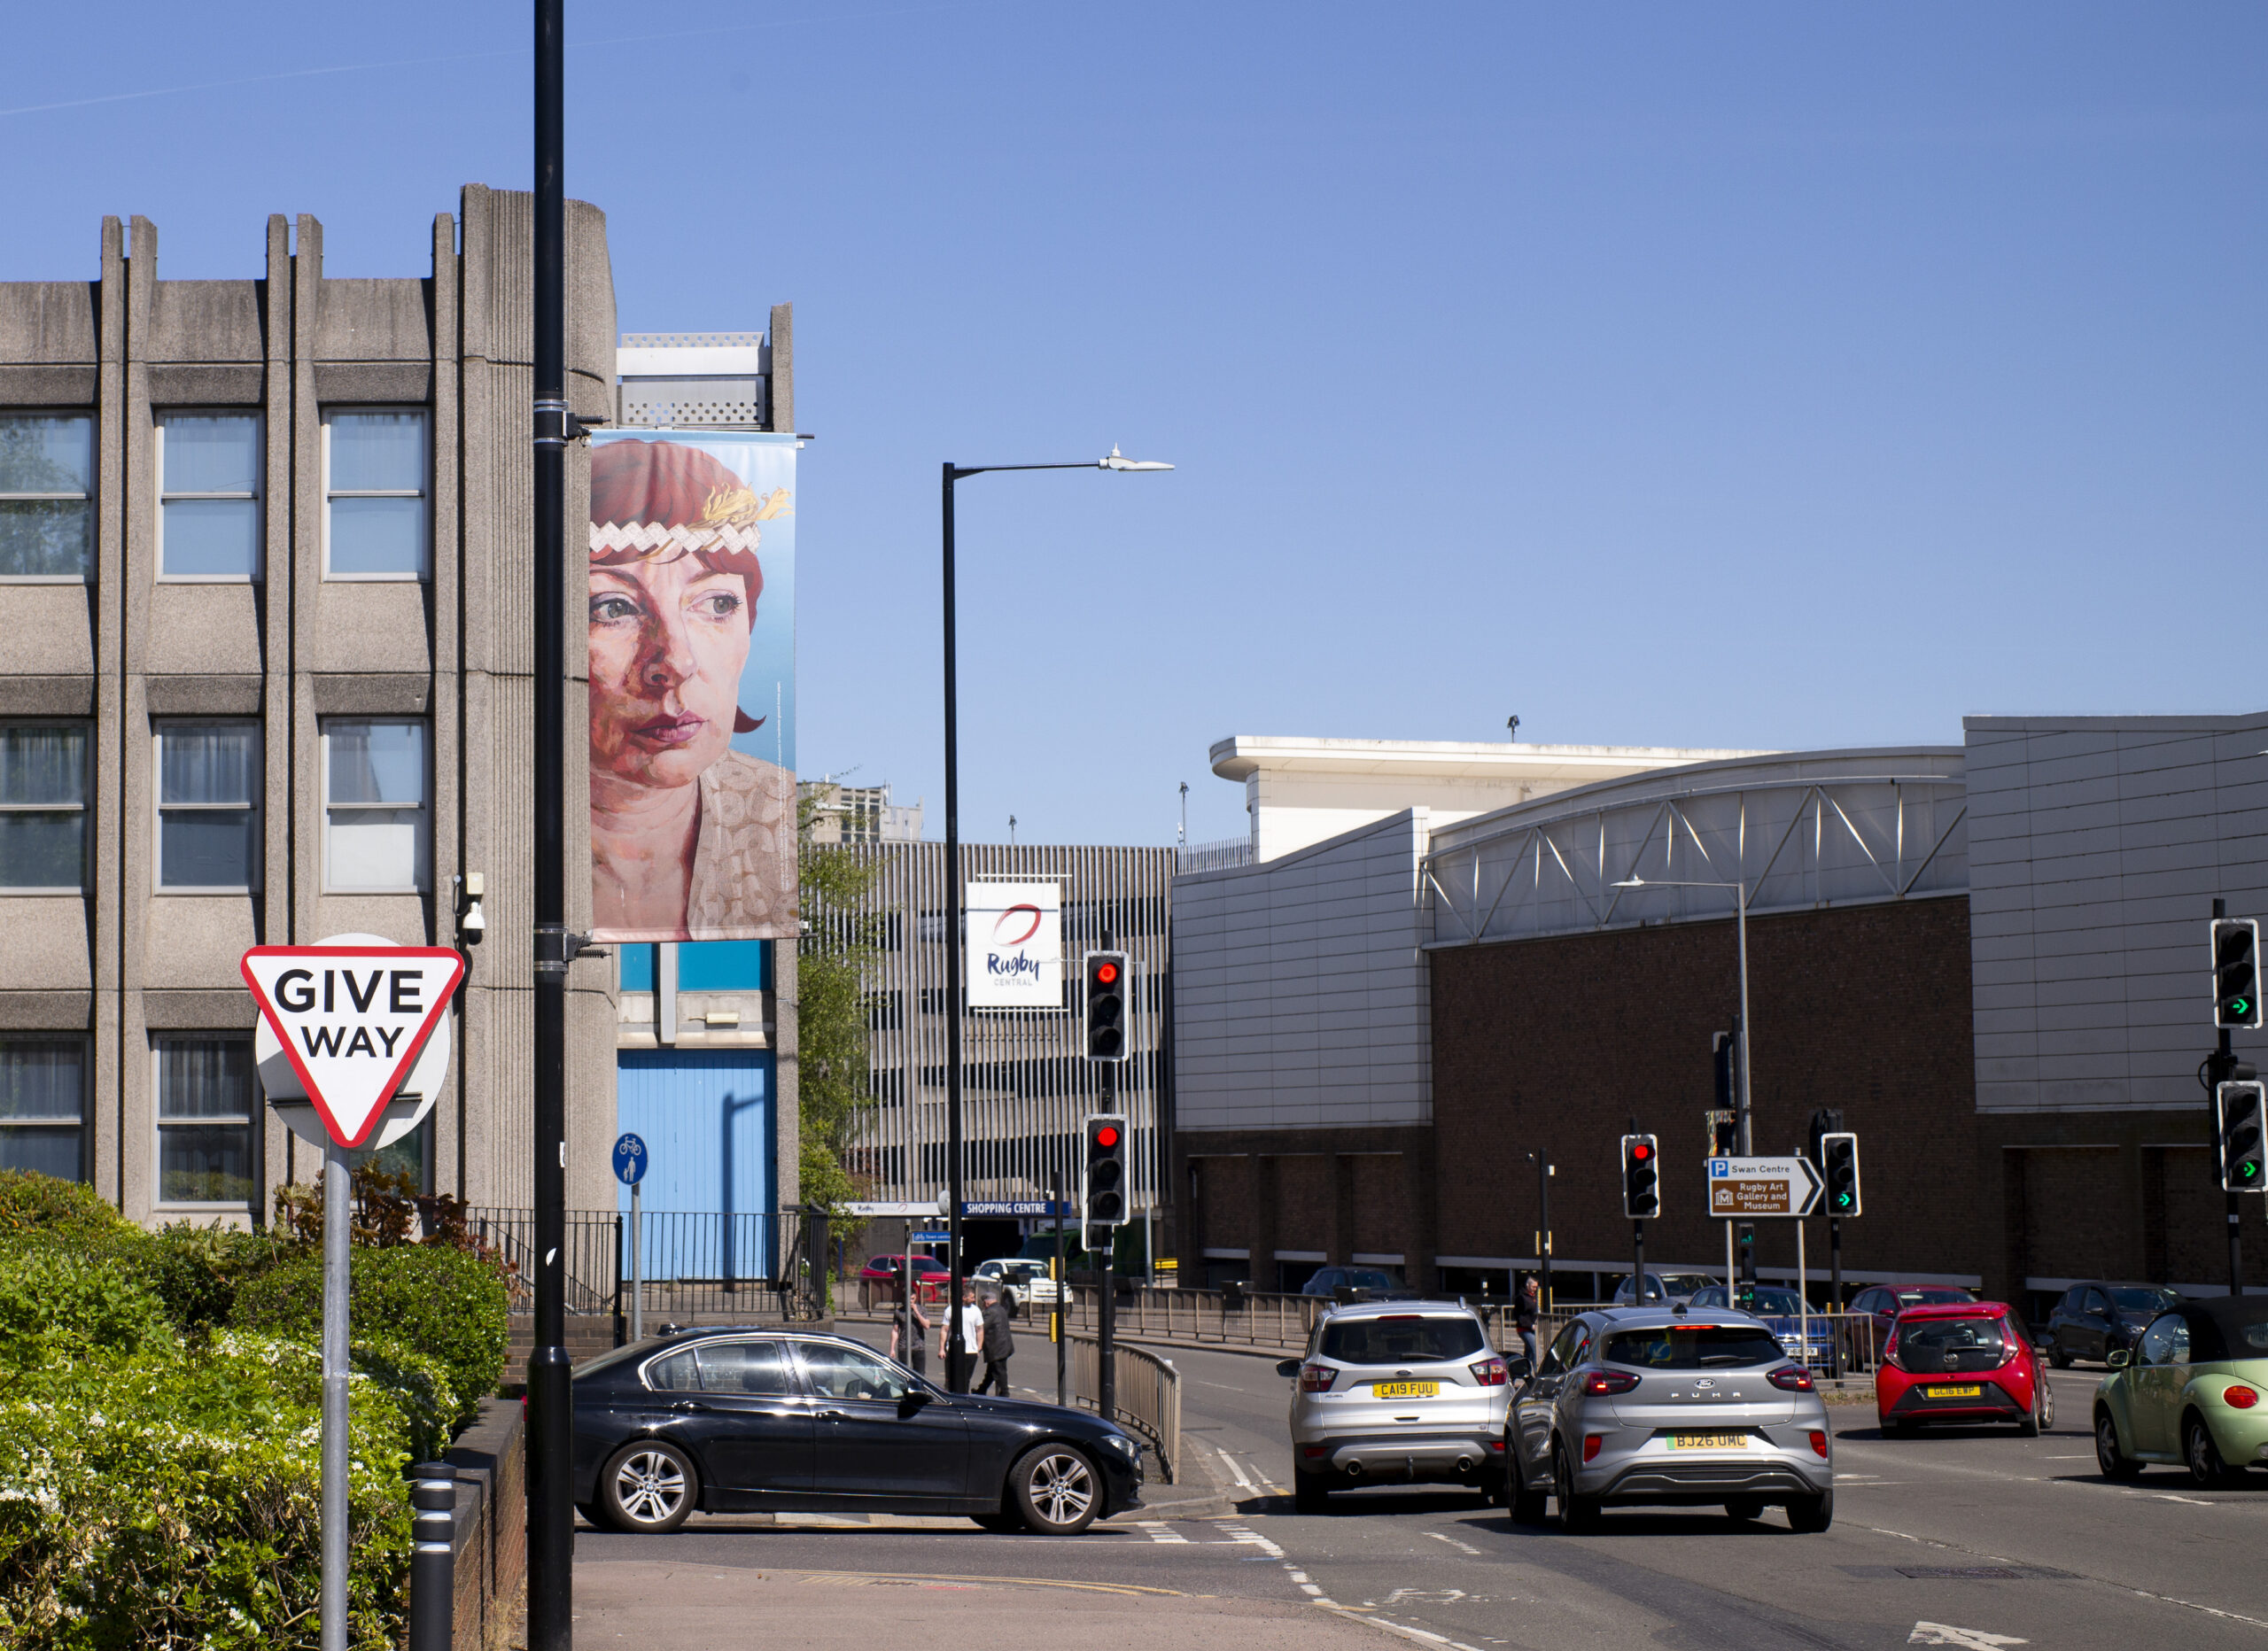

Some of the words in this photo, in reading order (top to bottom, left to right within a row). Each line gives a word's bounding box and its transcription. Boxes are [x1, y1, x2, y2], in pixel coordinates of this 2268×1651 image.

[987, 949, 1040, 982] Rugby
[994, 978, 1033, 987] CENTRAL
[274, 968, 423, 1013] GIVE
[300, 1026, 405, 1058] WAY
[1731, 1165, 1757, 1174] Swan
[1759, 1165, 1790, 1174] Centre
[1739, 1182, 1767, 1192] Rugby
[1736, 1191, 1768, 1201] Gallery
[967, 1203, 1012, 1213] SHOPPING
[1014, 1203, 1046, 1213] CENTRE
[1381, 1384, 1407, 1395] CA19
[1410, 1383, 1433, 1394] FUU
[1676, 1434, 1714, 1447] BJ26
[1718, 1433, 1745, 1446] UMC
